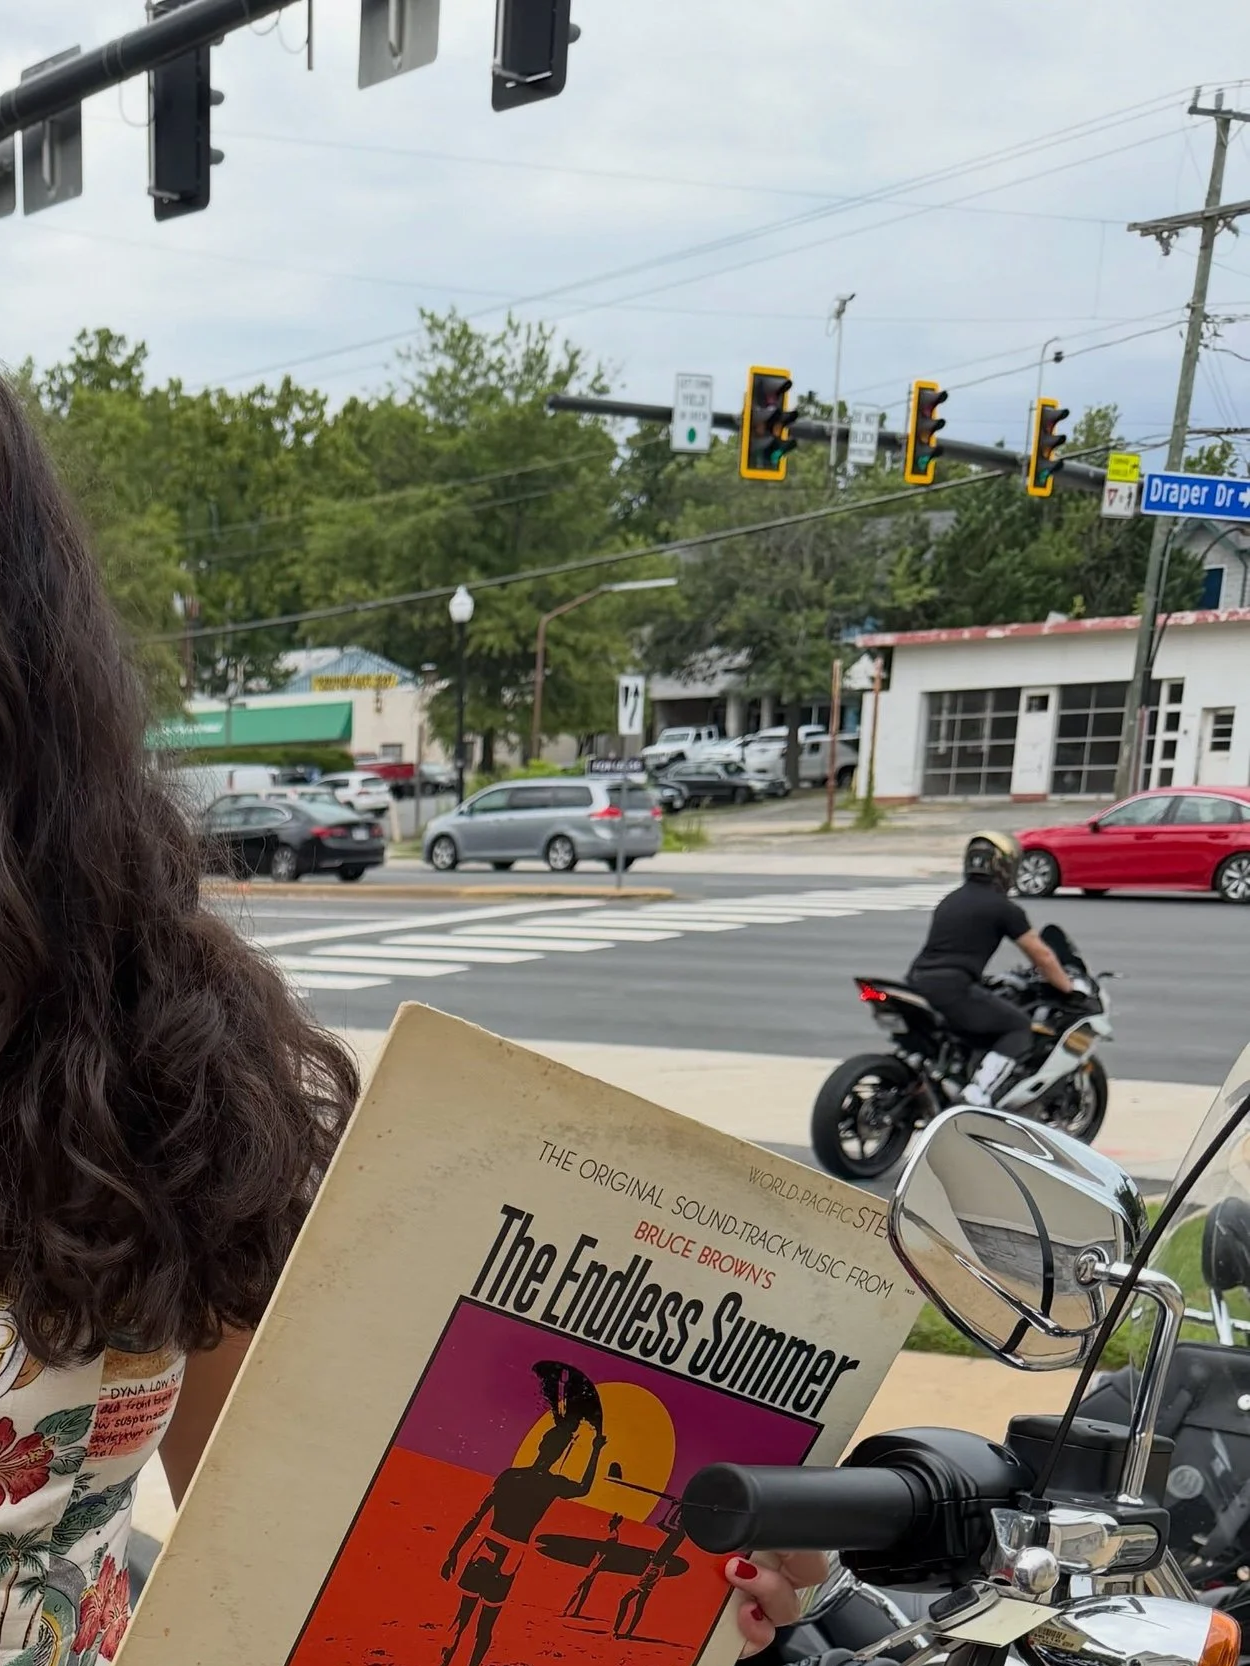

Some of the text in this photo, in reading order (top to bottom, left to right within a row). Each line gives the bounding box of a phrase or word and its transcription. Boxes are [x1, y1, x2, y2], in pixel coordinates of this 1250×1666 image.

[1150, 477, 1235, 510] Draper Dr
[537, 1140, 895, 1299] THE ORIGINAL SOUND-TRACK MUSIC FROM
[852, 1206, 889, 1240] STE
[634, 1220, 776, 1291] BRUCE BROWN'S
[470, 1203, 861, 1419] The Endless Summer
[110, 1384, 146, 1400] DYNA
